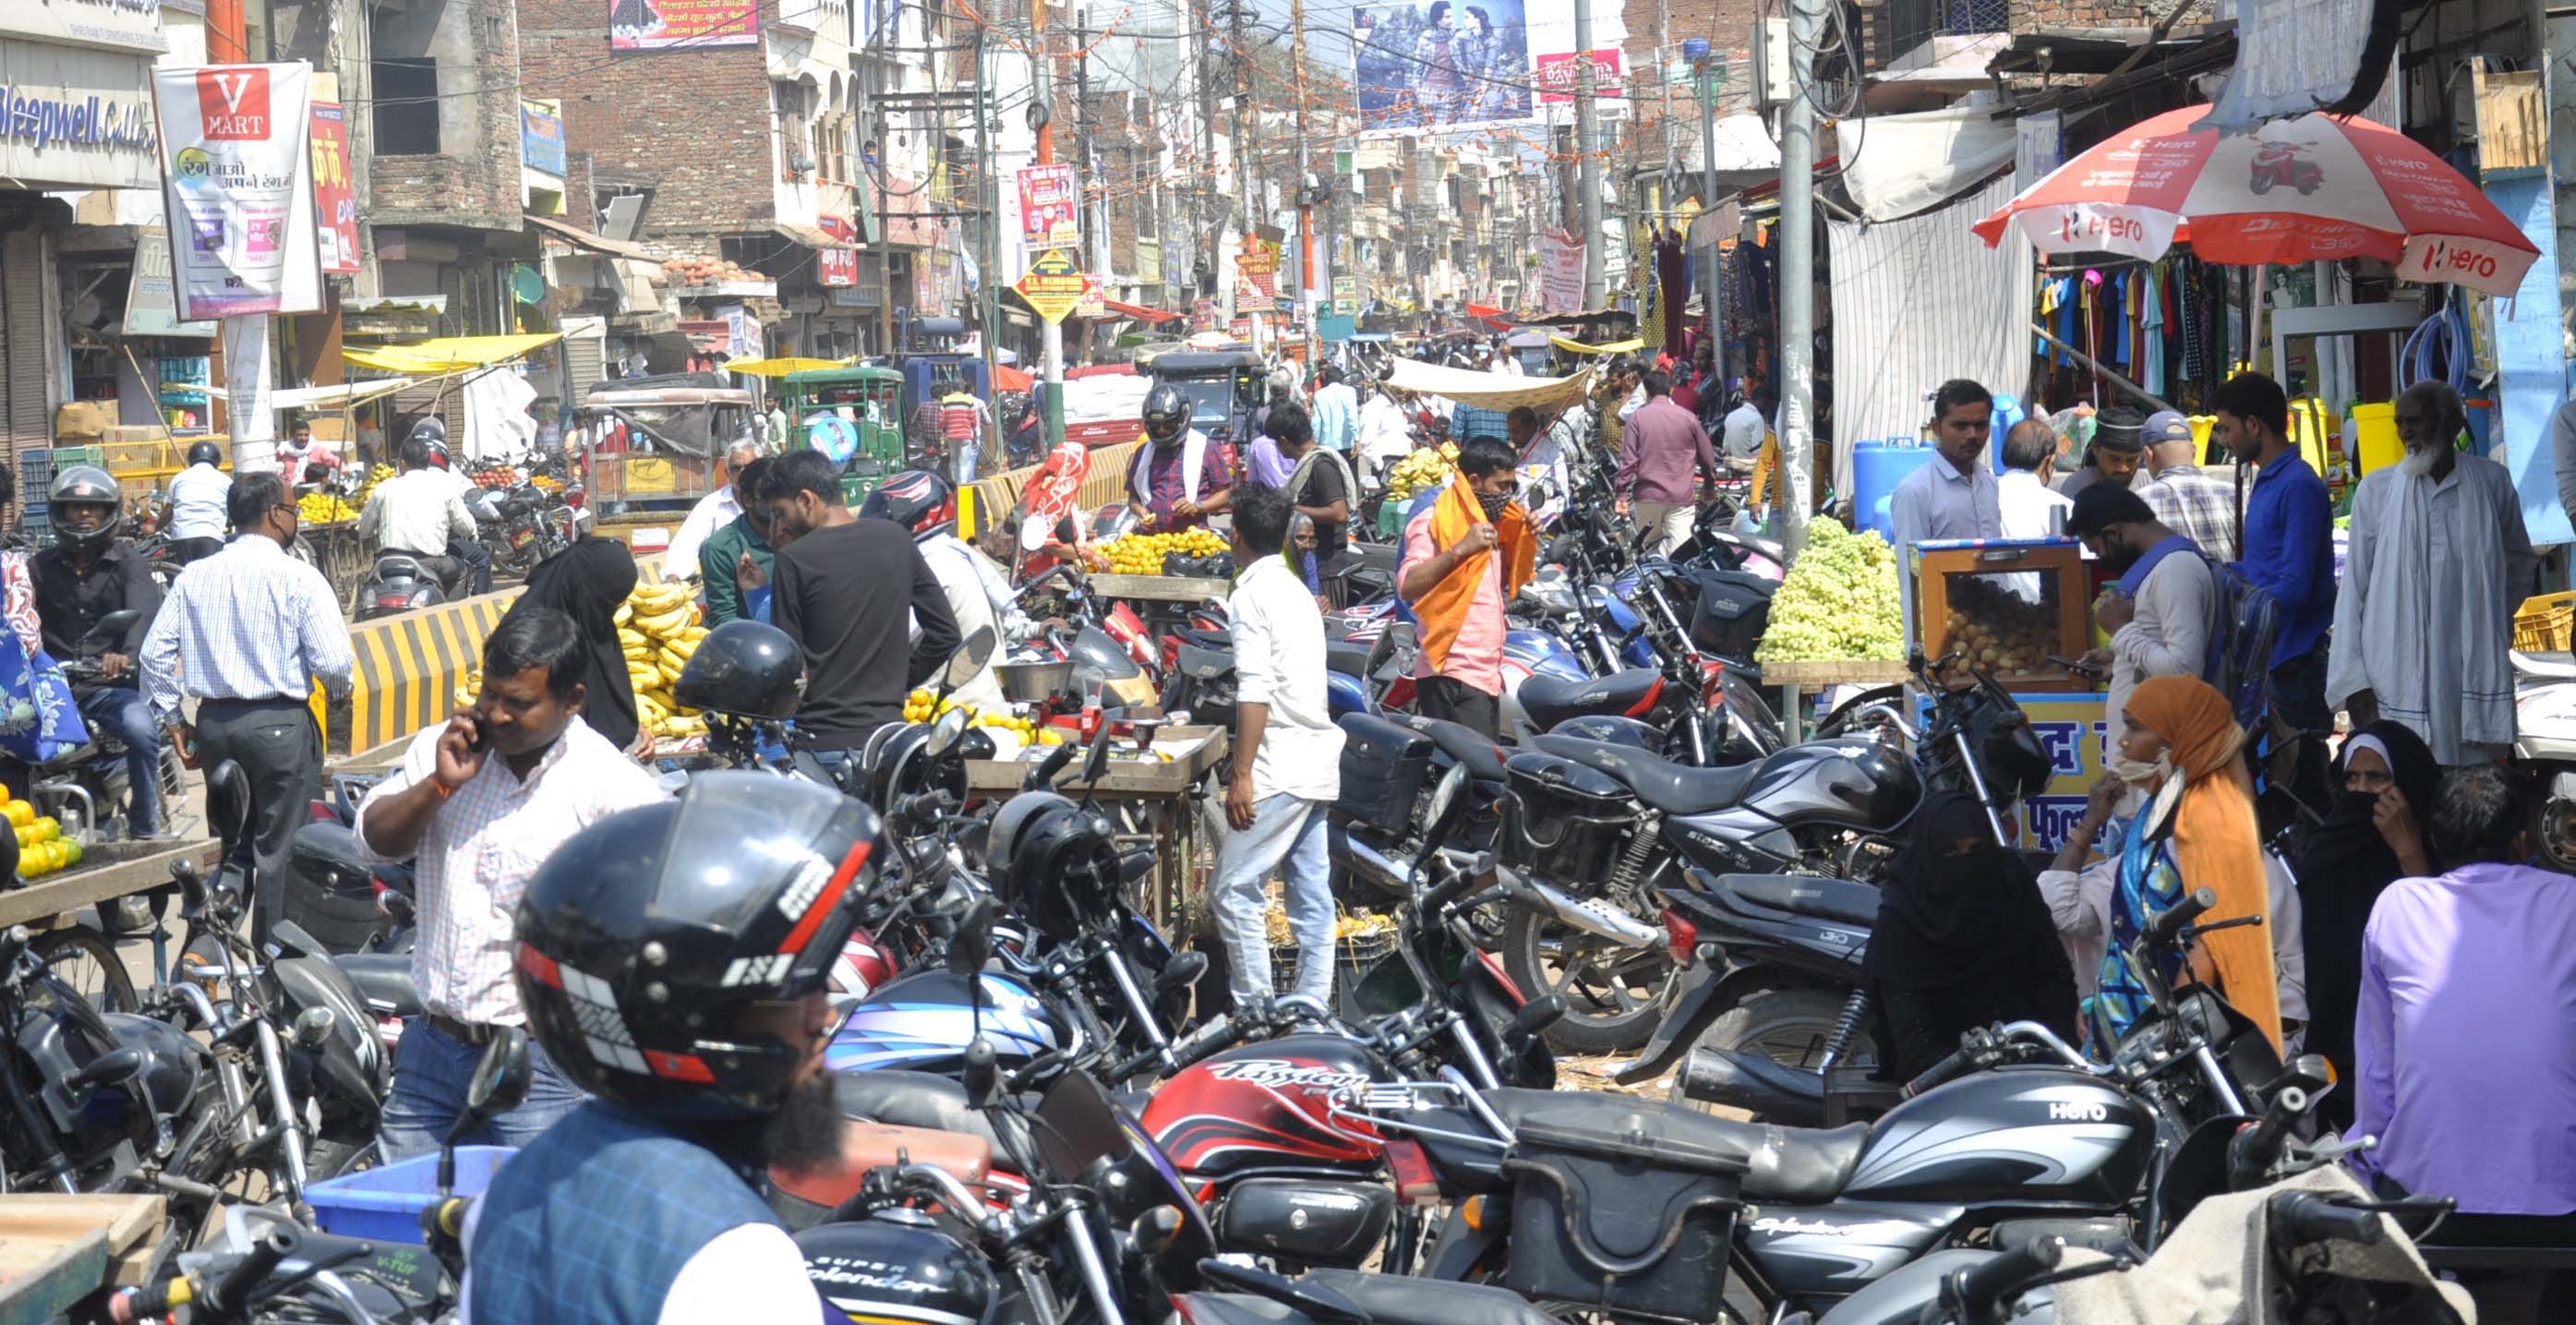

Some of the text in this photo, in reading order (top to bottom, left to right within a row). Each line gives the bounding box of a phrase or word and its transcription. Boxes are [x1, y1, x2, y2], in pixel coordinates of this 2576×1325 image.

[212, 74, 253, 114] V
[208, 116, 264, 135] MART
[182, 156, 210, 176] रंग
[2088, 215, 2143, 242] Hero
[2447, 247, 2497, 278] Hero
[815, 1256, 908, 1273] SUPER
